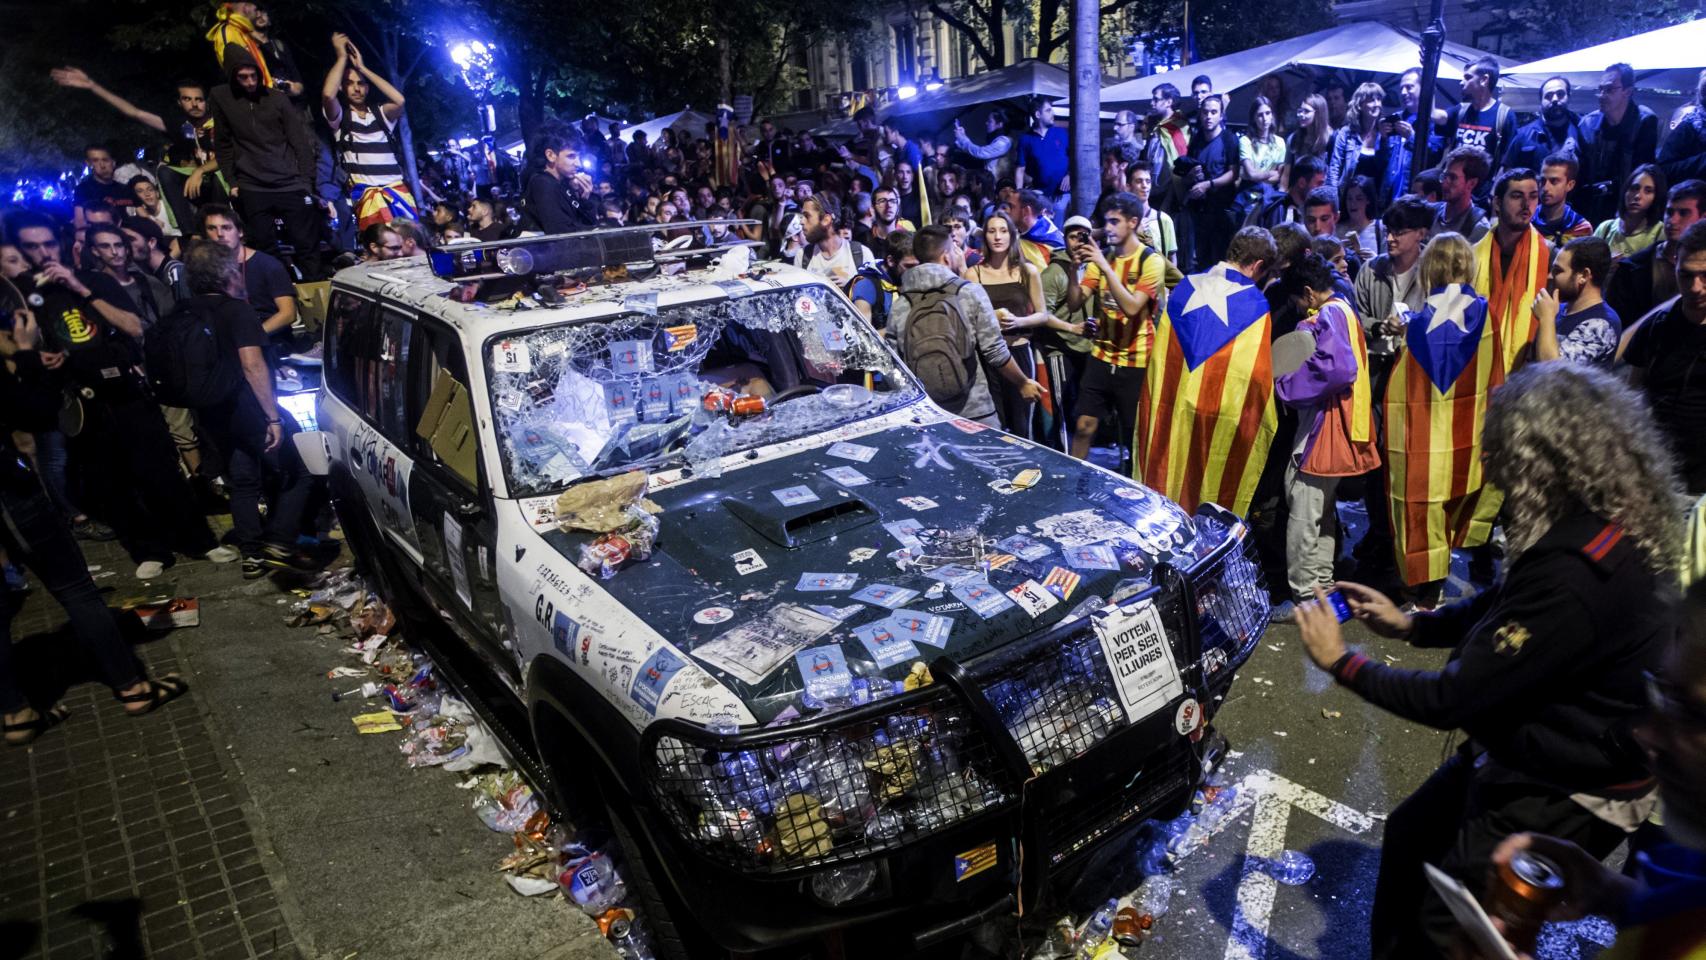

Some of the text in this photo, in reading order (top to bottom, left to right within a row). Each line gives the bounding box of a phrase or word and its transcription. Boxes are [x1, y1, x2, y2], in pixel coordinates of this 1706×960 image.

[1456, 128, 1489, 145] FCK
[535, 593, 555, 635] G.R.
[927, 602, 965, 612] VOTAREM
[1112, 620, 1151, 647] VOTEM
[1114, 633, 1159, 664] PER SER
[1119, 647, 1163, 678] LLIURES
[680, 693, 719, 709] ESCAC
